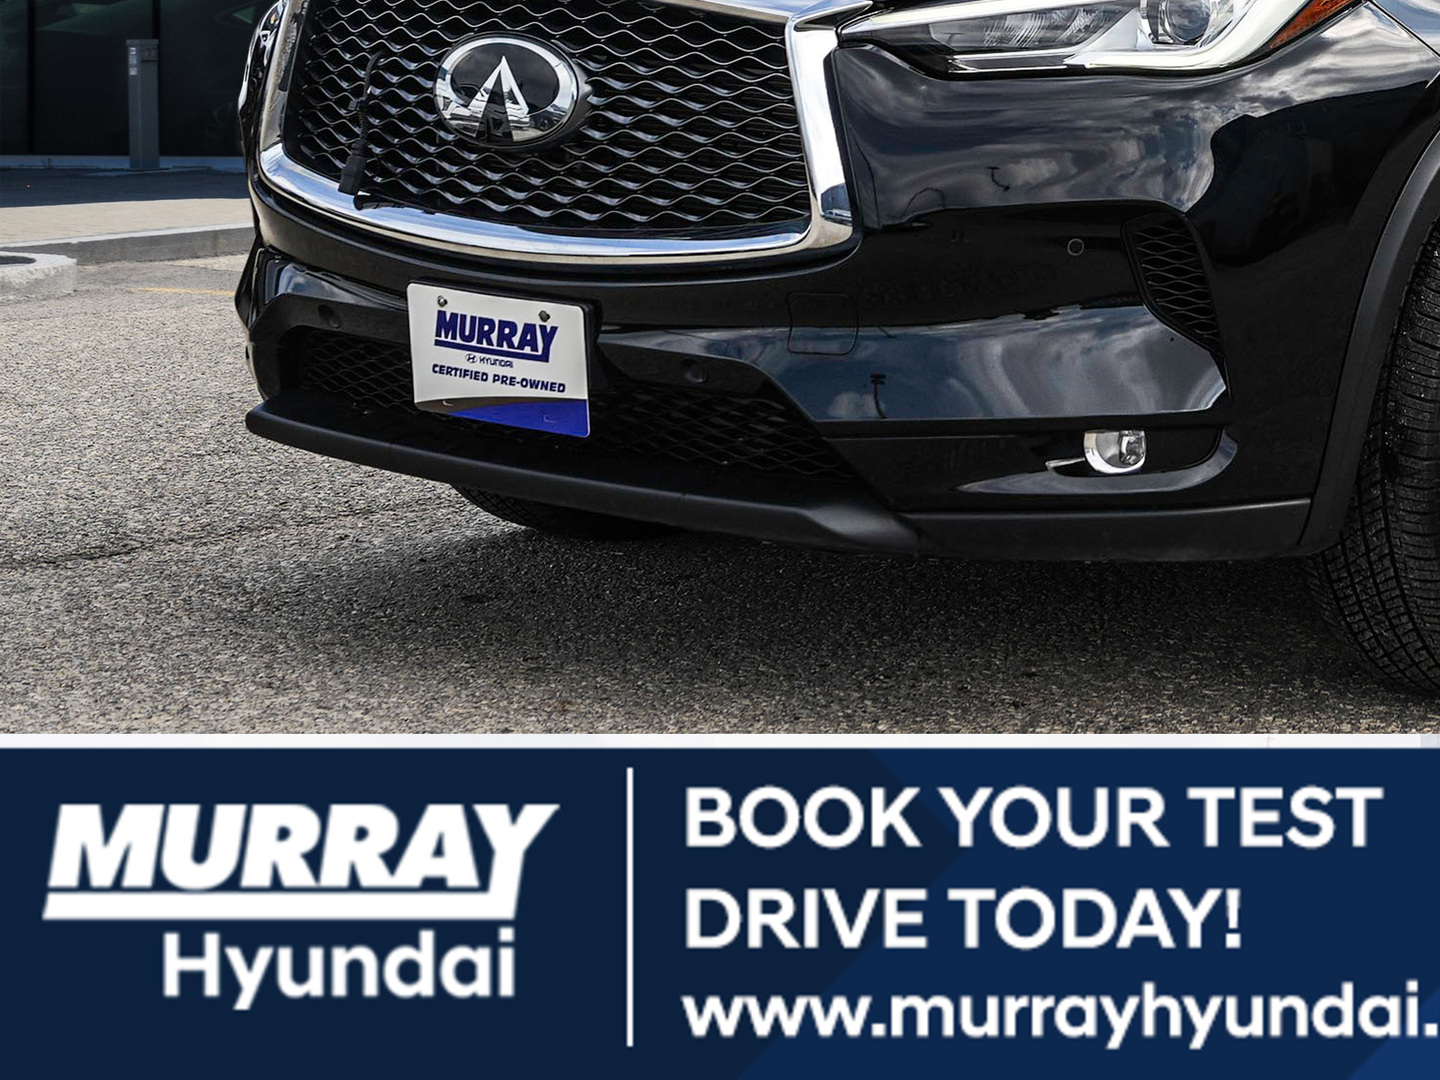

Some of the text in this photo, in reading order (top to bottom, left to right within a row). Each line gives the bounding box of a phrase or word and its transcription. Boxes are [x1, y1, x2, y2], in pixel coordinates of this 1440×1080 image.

[434, 309, 559, 363] MURRAY
[479, 356, 514, 369] HYUNDAI
[431, 363, 567, 394] CERTIFIED PRE-OWNED
